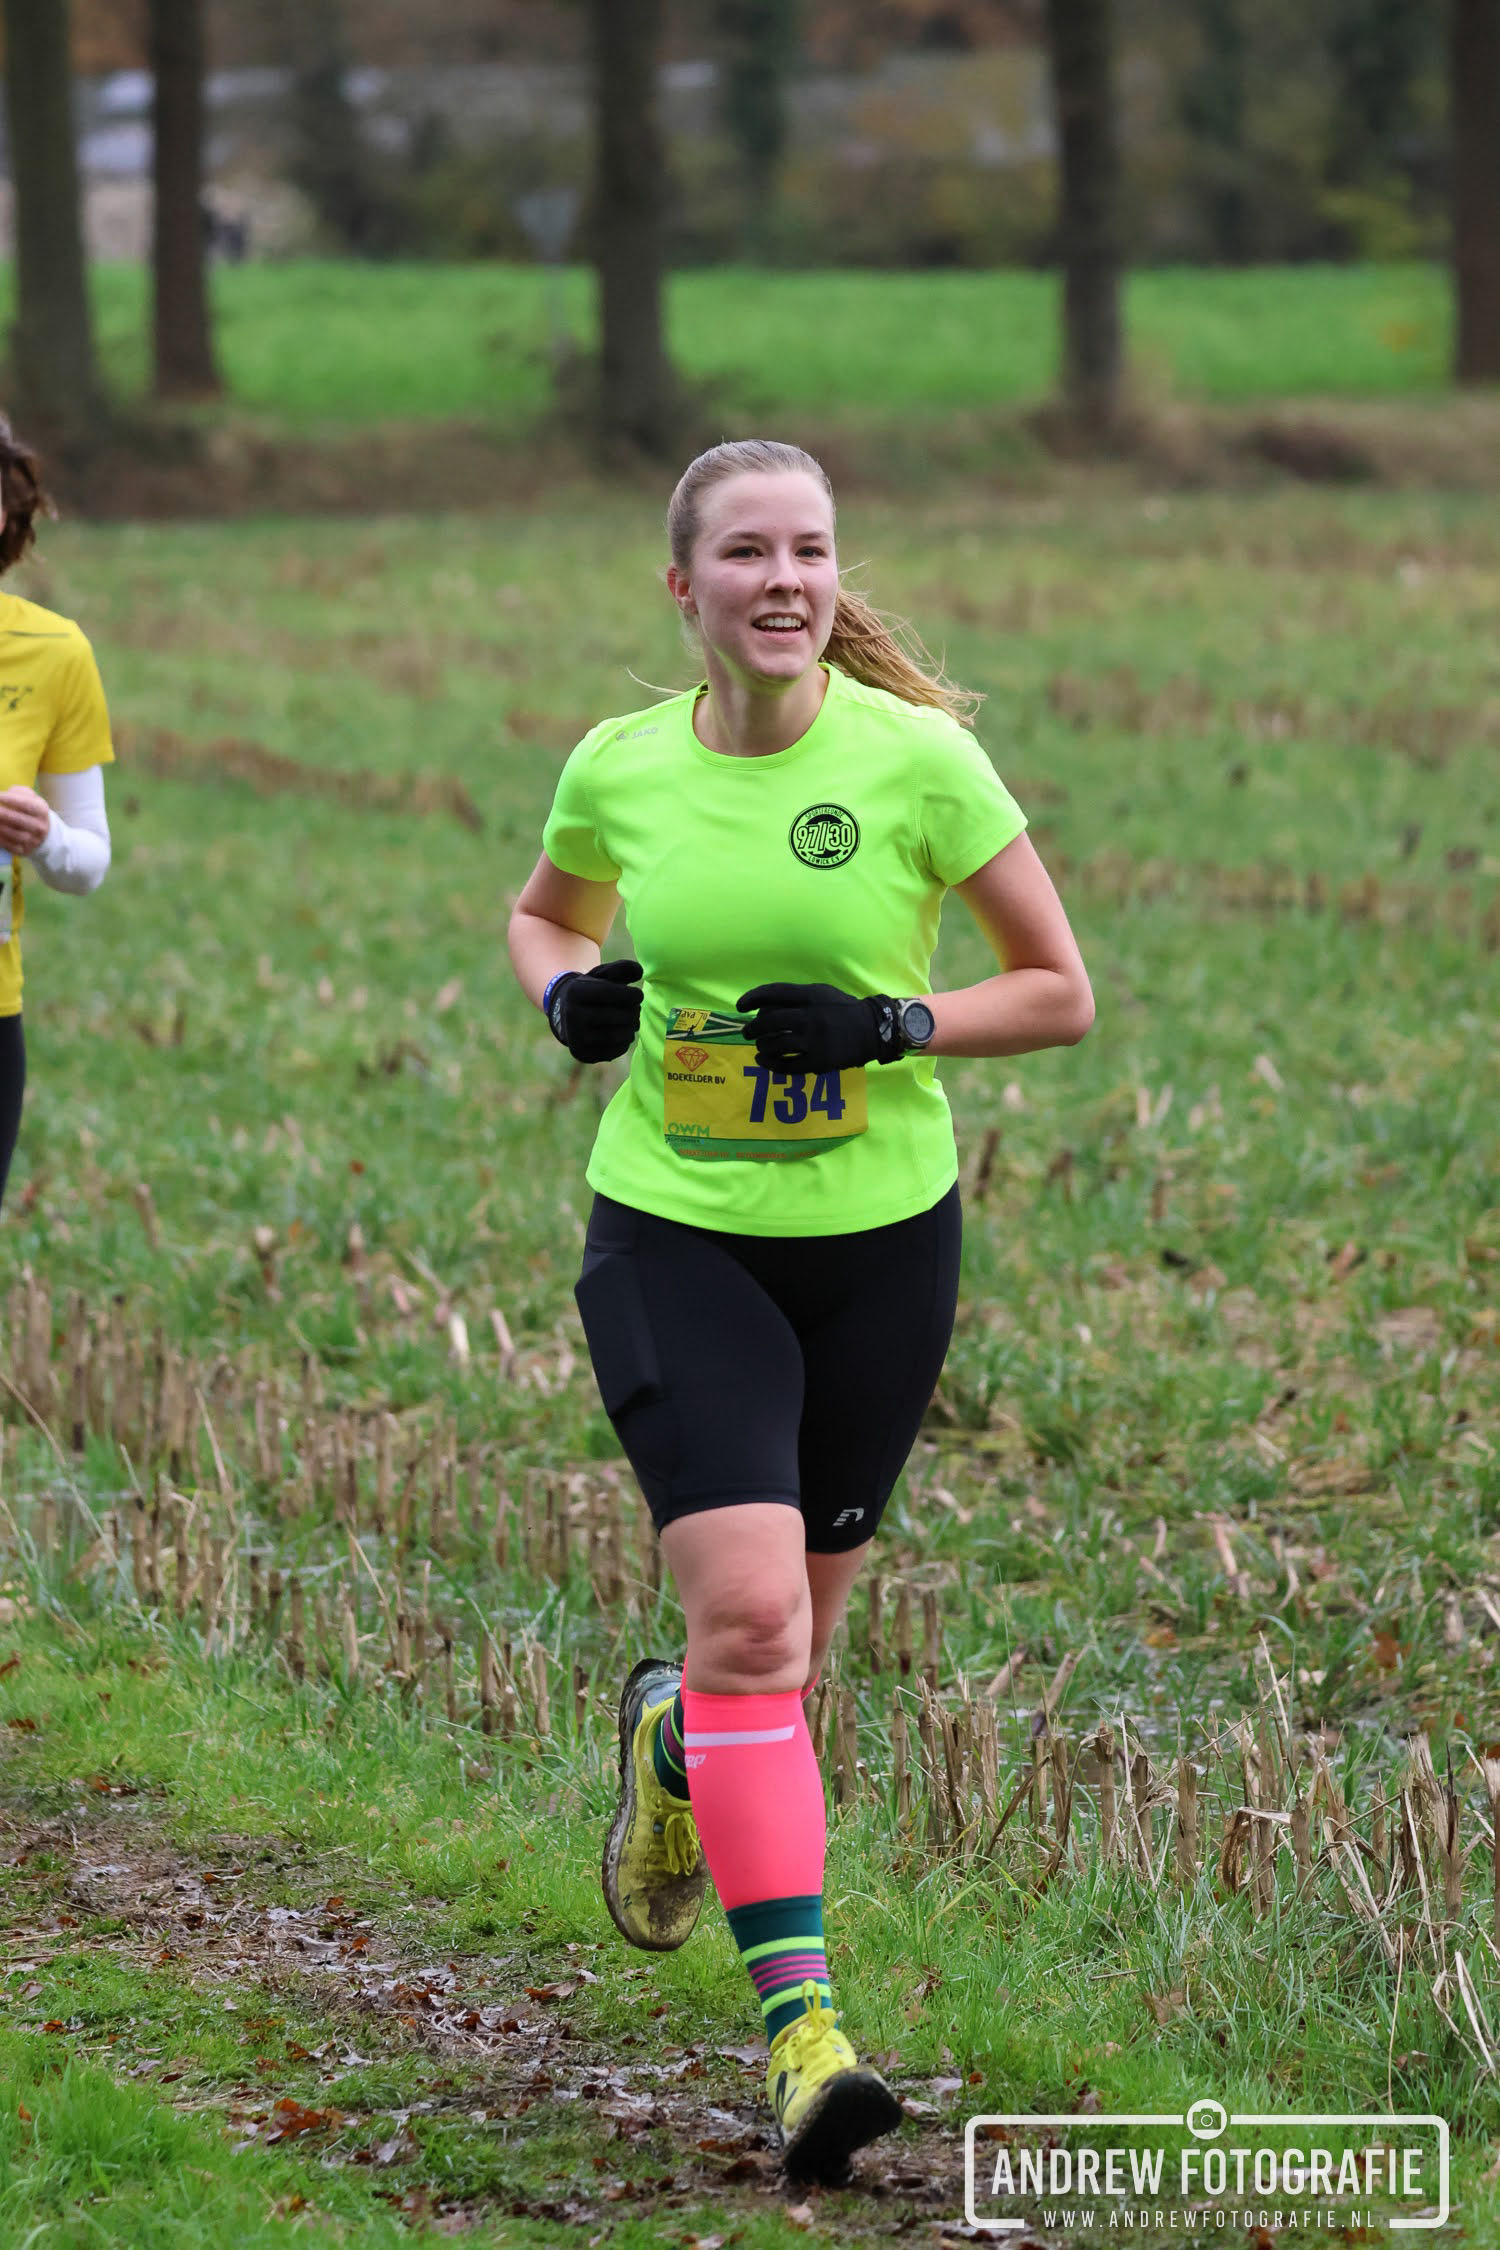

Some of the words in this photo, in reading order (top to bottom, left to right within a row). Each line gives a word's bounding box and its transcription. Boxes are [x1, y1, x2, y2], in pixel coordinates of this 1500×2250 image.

[681, 1010, 696, 1019] ava
[667, 1072, 713, 1084] BOEKELDER
[714, 1076, 726, 1085] BV
[743, 1066, 847, 1124] 734
[667, 1122, 710, 1137] OWM
